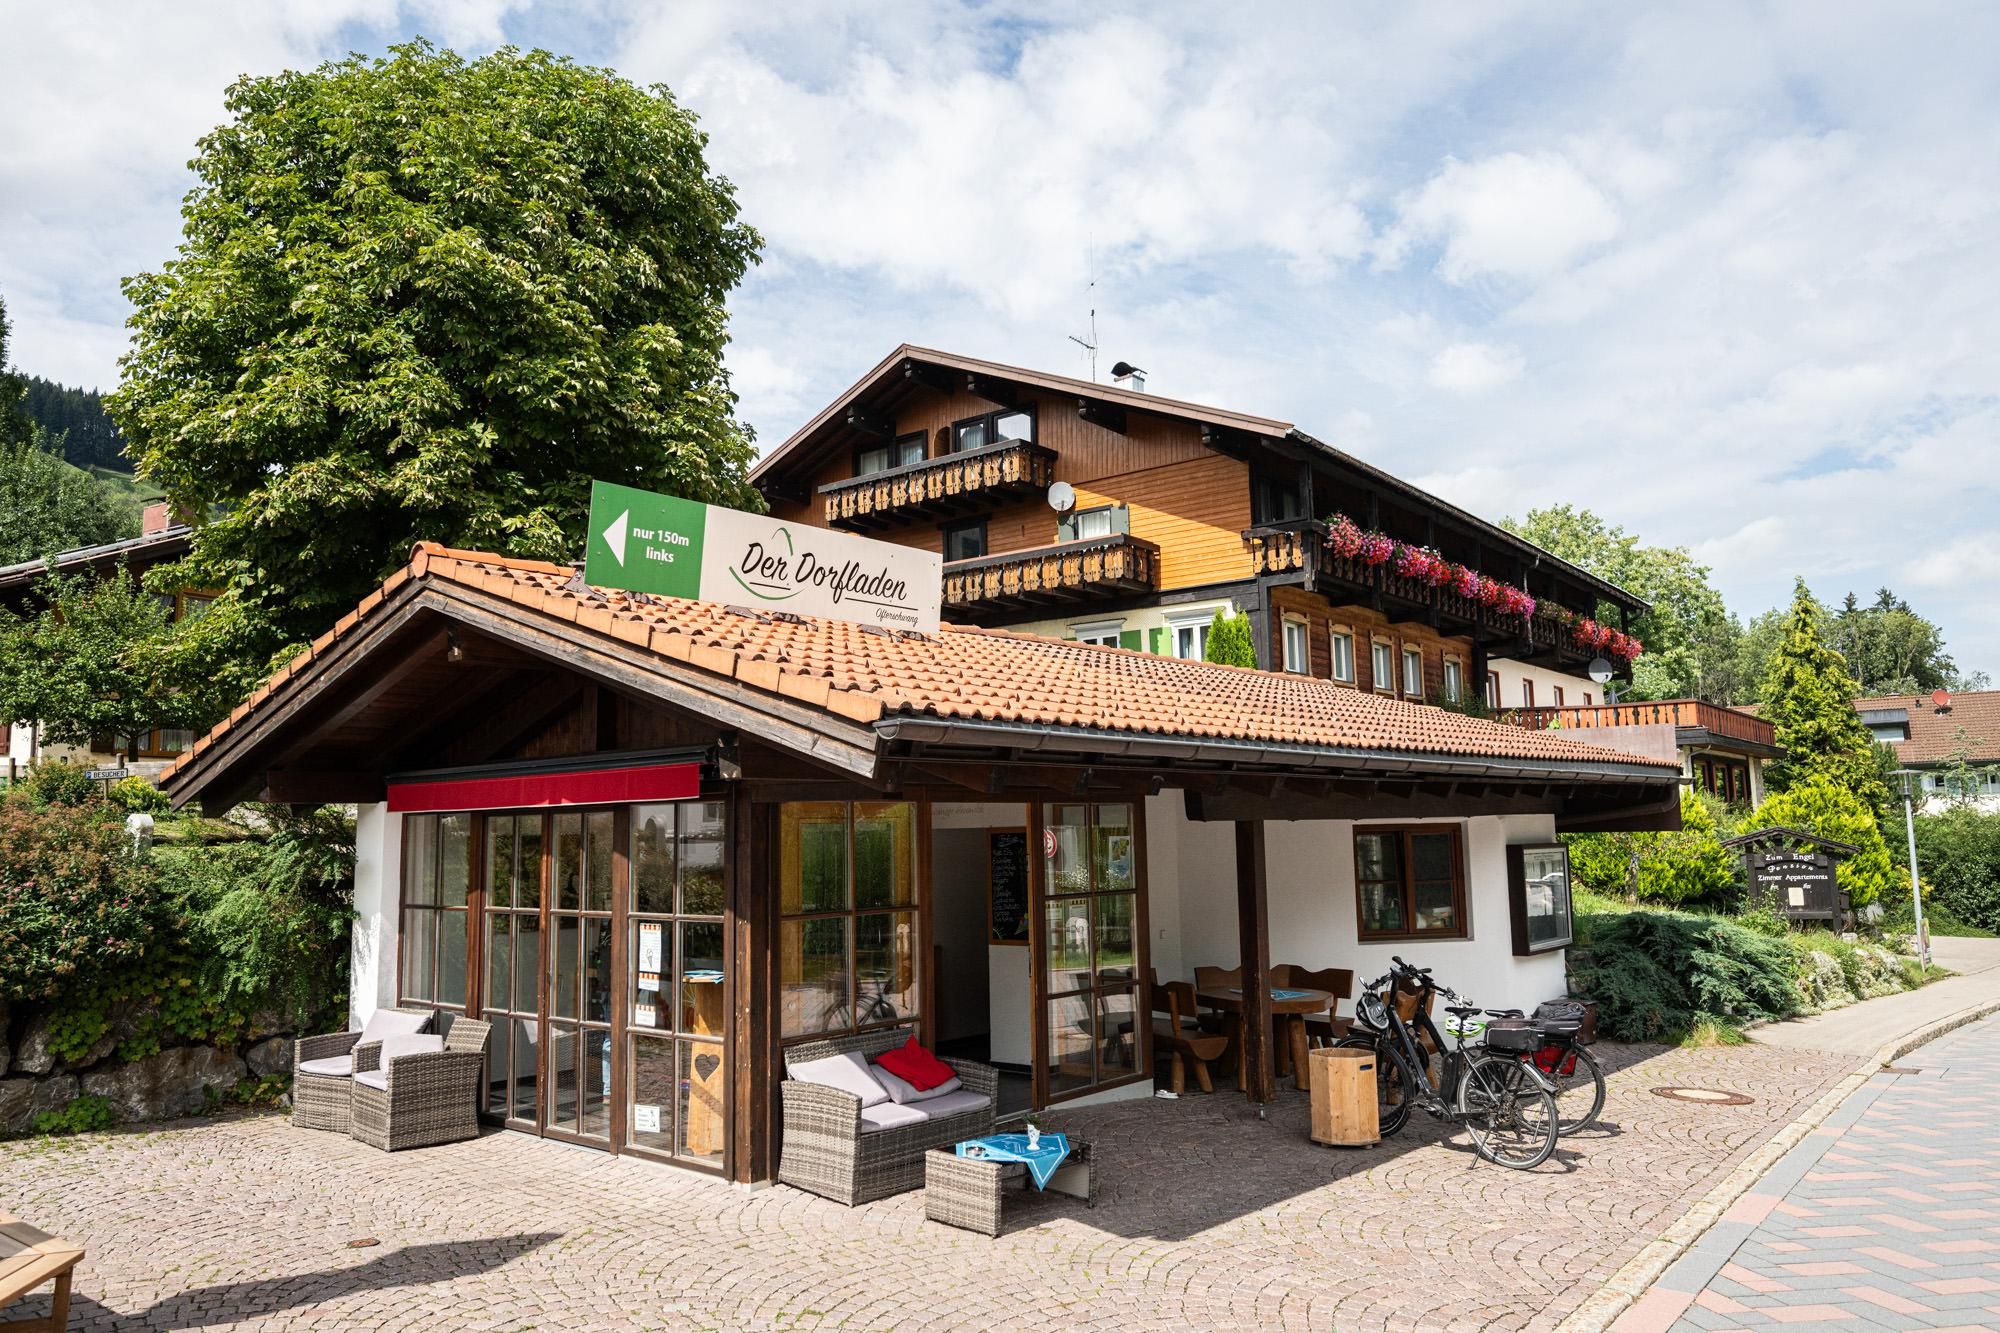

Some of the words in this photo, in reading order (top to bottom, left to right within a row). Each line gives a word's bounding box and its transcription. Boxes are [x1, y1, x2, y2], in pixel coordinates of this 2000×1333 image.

[633, 527, 655, 540] nur
[657, 529, 690, 547] 150m
[645, 545, 675, 563] links
[741, 542, 788, 581] Der
[795, 552, 907, 604] Dorfladen
[875, 607, 919, 627] Ofterschwang
[93, 770, 125, 778] BESUCHER
[1792, 853, 1815, 862] Engel
[1767, 863, 1814, 873] Pension
[1785, 874, 1828, 882] Appartements
